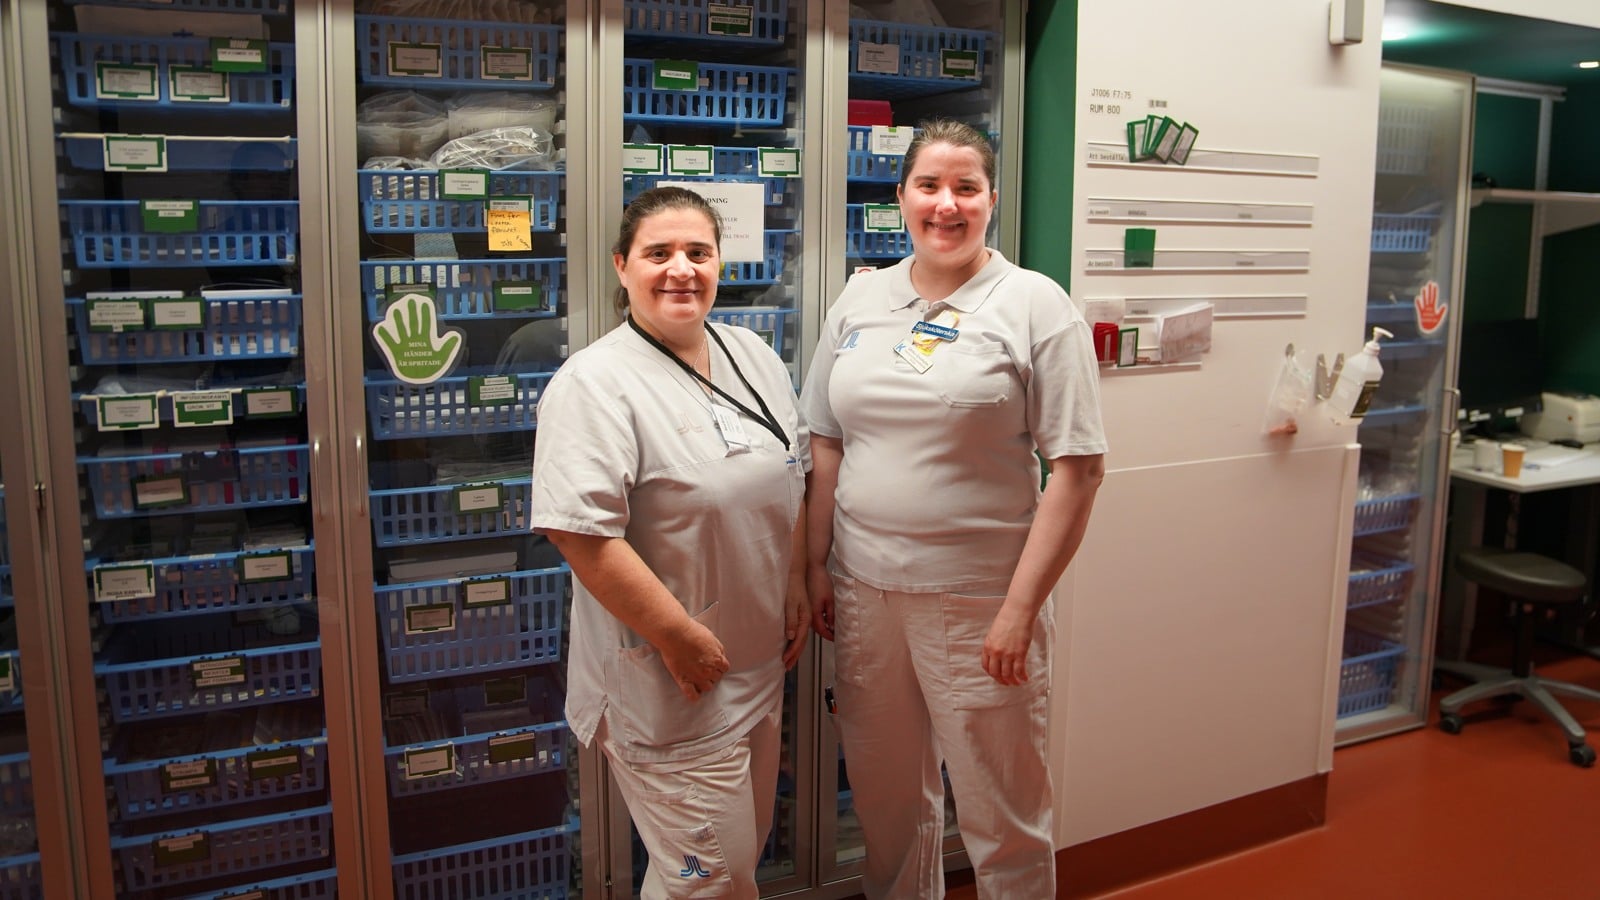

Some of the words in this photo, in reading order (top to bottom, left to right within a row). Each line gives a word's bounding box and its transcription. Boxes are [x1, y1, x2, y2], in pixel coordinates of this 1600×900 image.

[1091, 89, 1110, 98] J1006
[1089, 104, 1104, 113] RUM
[1107, 105, 1121, 114] 800
[399, 359, 408, 367] ÄR
[408, 359, 442, 367] SPRITADE
